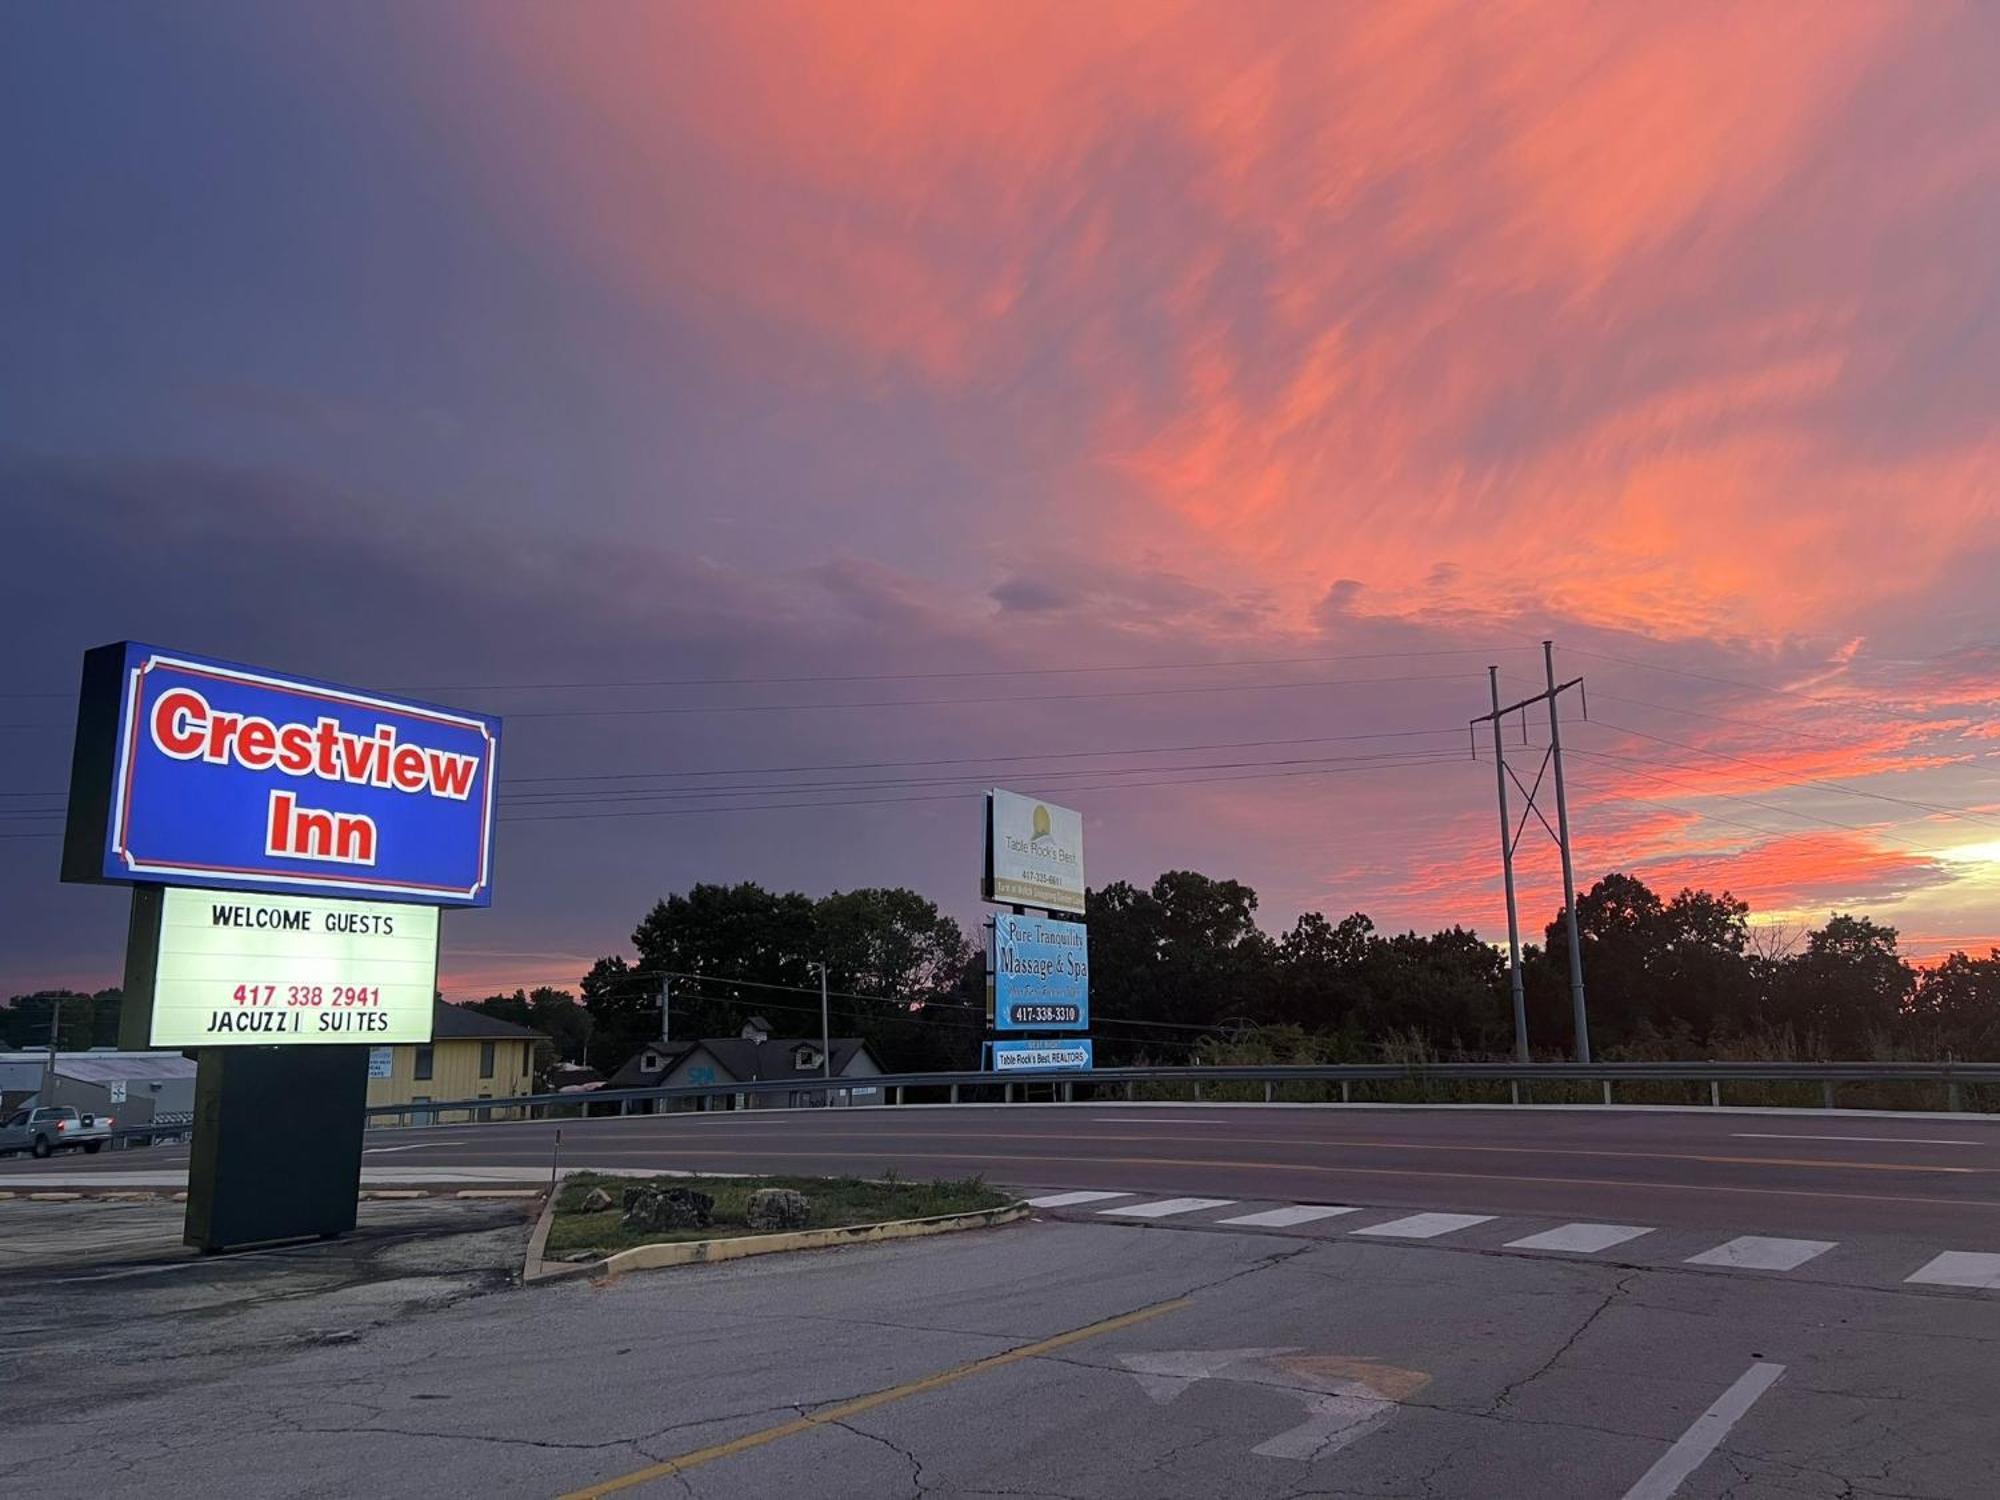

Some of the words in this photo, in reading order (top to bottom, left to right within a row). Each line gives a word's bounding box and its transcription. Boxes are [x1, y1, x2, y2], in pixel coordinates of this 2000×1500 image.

[150, 687, 479, 800] Crestview
[265, 789, 376, 866] Inn
[1006, 836, 1029, 854] Table
[1030, 842, 1057, 861] Rock's
[212, 905, 312, 931] WELCOME
[325, 913, 394, 935] GUESTS
[1009, 922, 1033, 943] Pure
[1034, 925, 1083, 950] Tranquility
[1001, 947, 1053, 980] Massage
[1056, 954, 1064, 973] &
[1067, 951, 1087, 982] Spa
[233, 984, 276, 1006] 417
[287, 986, 323, 1006] 338
[331, 987, 380, 1007] 2941
[206, 1011, 300, 1032] JACUZZI
[319, 1012, 389, 1032] SUITES
[1016, 1007, 1076, 1021] 417-338-3310
[1000, 1055, 1015, 1065] Table
[1016, 1054, 1036, 1065] Rock's
[1051, 1051, 1084, 1064] REALTORS
